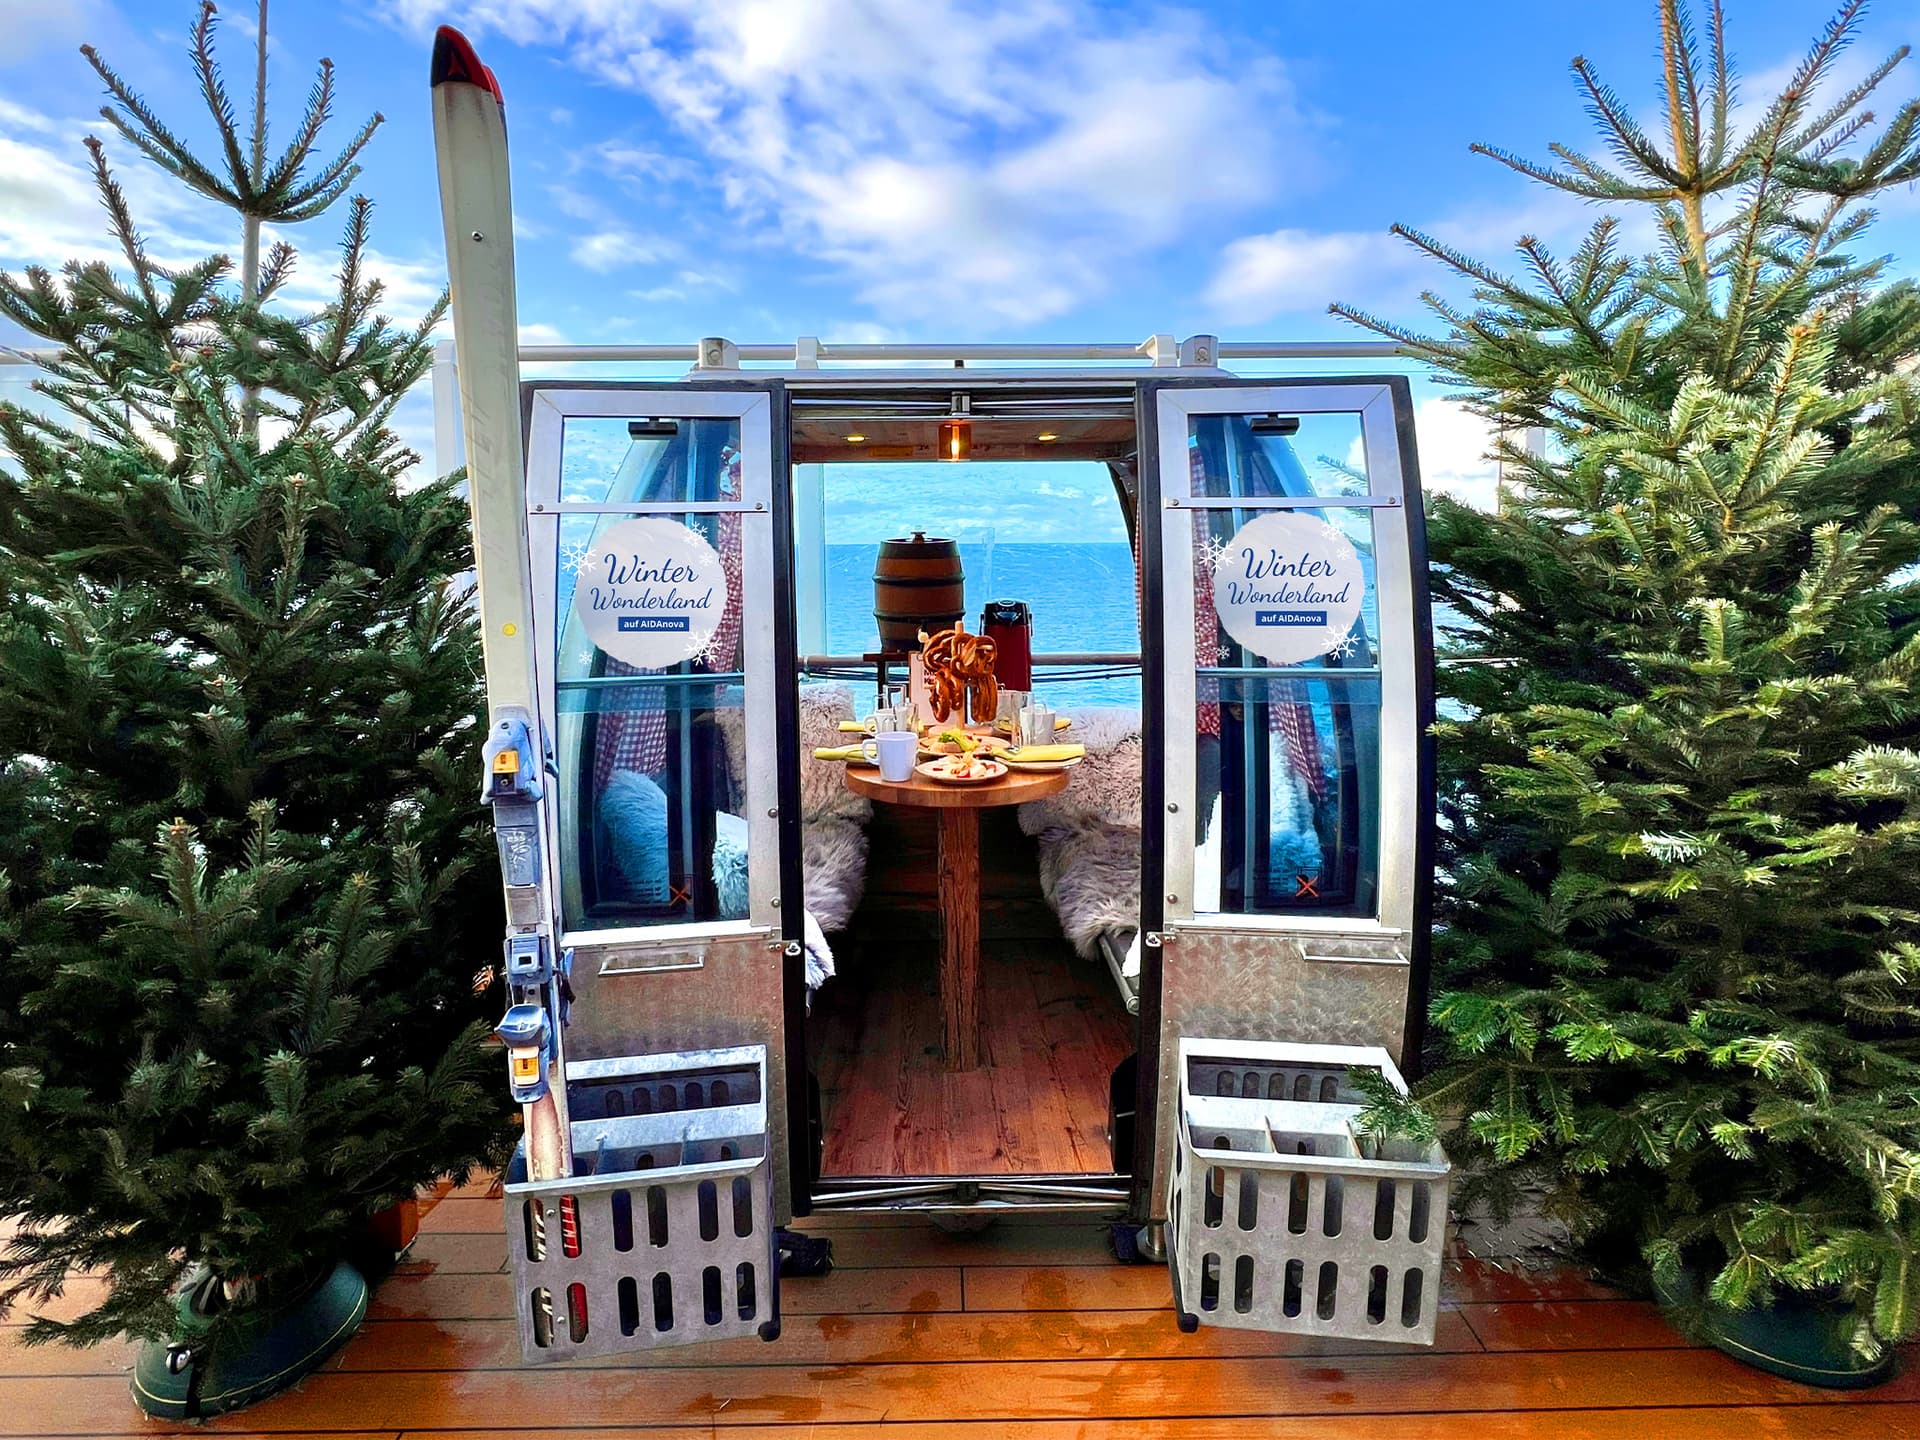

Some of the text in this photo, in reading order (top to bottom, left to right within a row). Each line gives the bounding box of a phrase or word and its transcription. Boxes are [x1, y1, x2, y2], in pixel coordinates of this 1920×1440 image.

[604, 553, 699, 585] Winter
[1241, 547, 1337, 579] Winter
[590, 587, 713, 611] Wonderland
[1227, 581, 1351, 605] Wonderland
[623, 620, 685, 629] auf AIDAnova
[1261, 614, 1322, 623] auf AIDAnova
